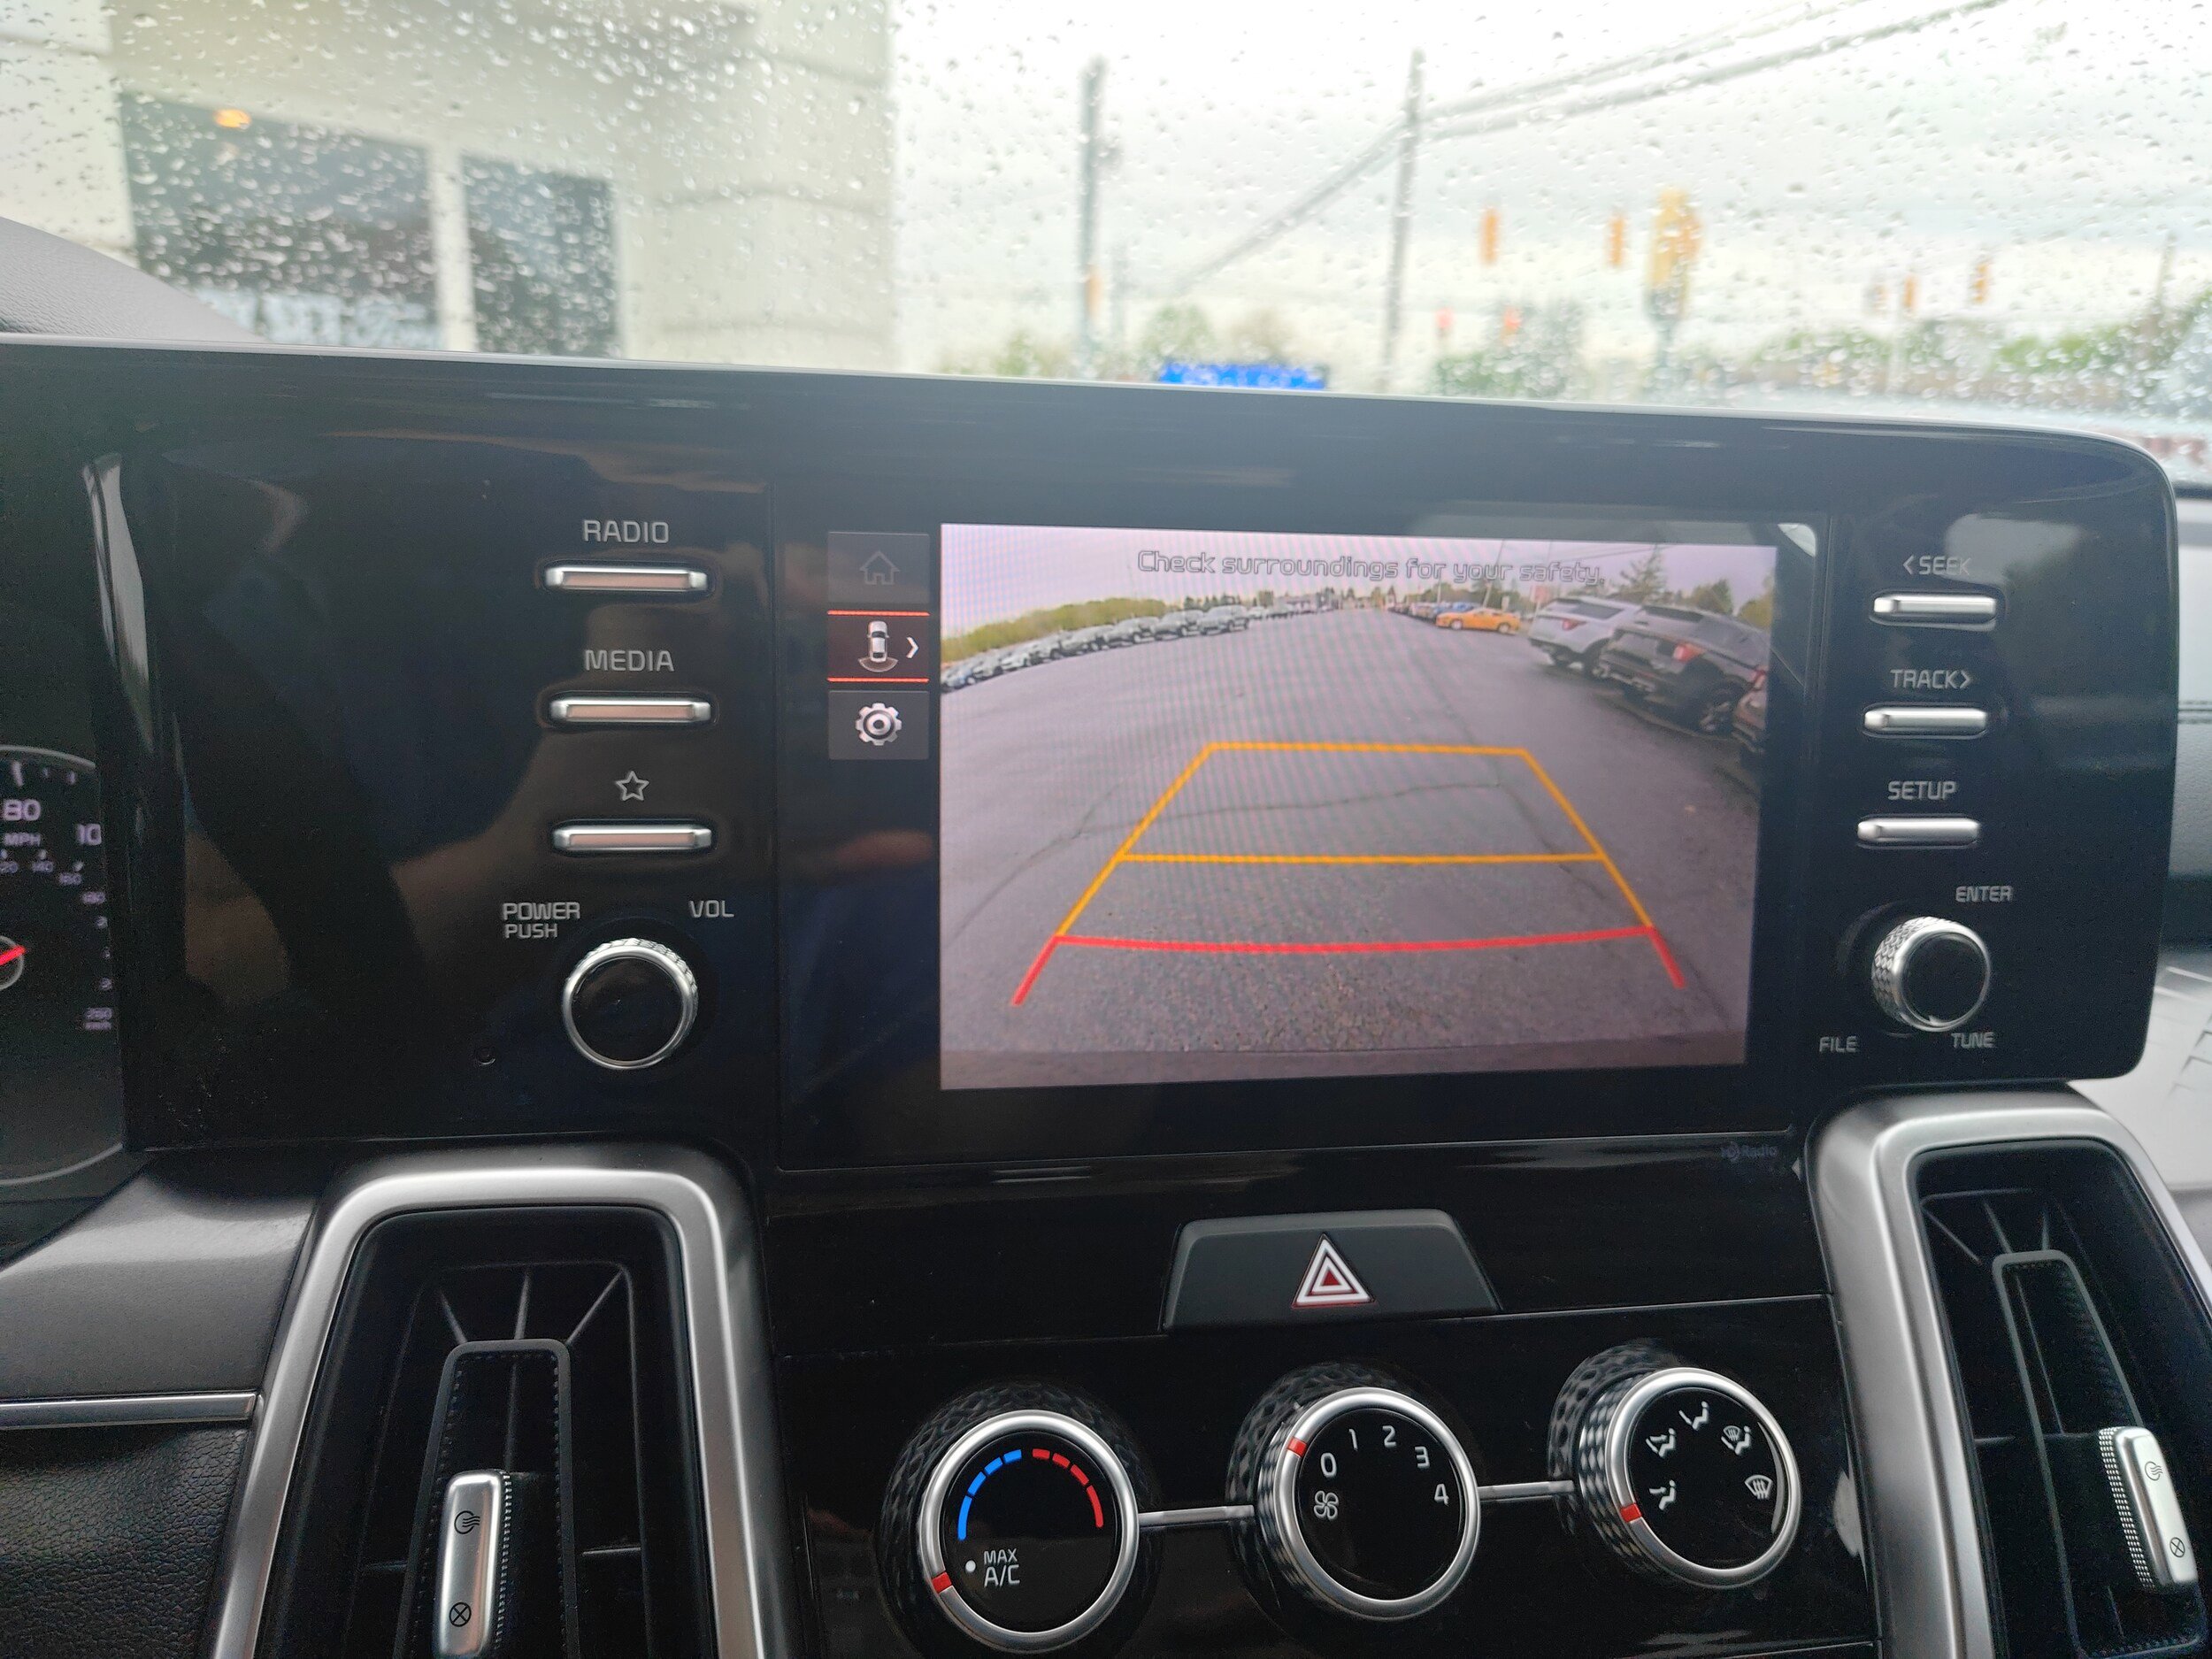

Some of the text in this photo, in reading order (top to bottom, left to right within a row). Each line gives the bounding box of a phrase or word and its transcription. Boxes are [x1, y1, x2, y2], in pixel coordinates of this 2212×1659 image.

[582, 519, 670, 544] RADIO
[1138, 549, 1216, 573] Check
[1222, 556, 1399, 582] surroundings
[1405, 557, 1447, 580] for
[1453, 562, 1513, 584] your
[1918, 555, 1971, 576] SEEK
[584, 649, 675, 672] MEDIA
[1890, 668, 1958, 690] TRACK
[1888, 780, 1957, 800] SETUP
[1955, 886, 2012, 902] ENTER
[502, 902, 581, 921] POWER
[689, 900, 734, 918] VOL
[504, 923, 558, 940] PUSH
[1820, 1036, 1857, 1053] FILE
[1952, 1032, 1995, 1049] TUNE
[1348, 1428, 1358, 1451] 1
[1382, 1425, 1397, 1448] 2
[1415, 1446, 1430, 1469] 3
[1433, 1483, 1449, 1506] 4
[983, 1548, 1018, 1565] MAX
[983, 1563, 1020, 1588] A/C
